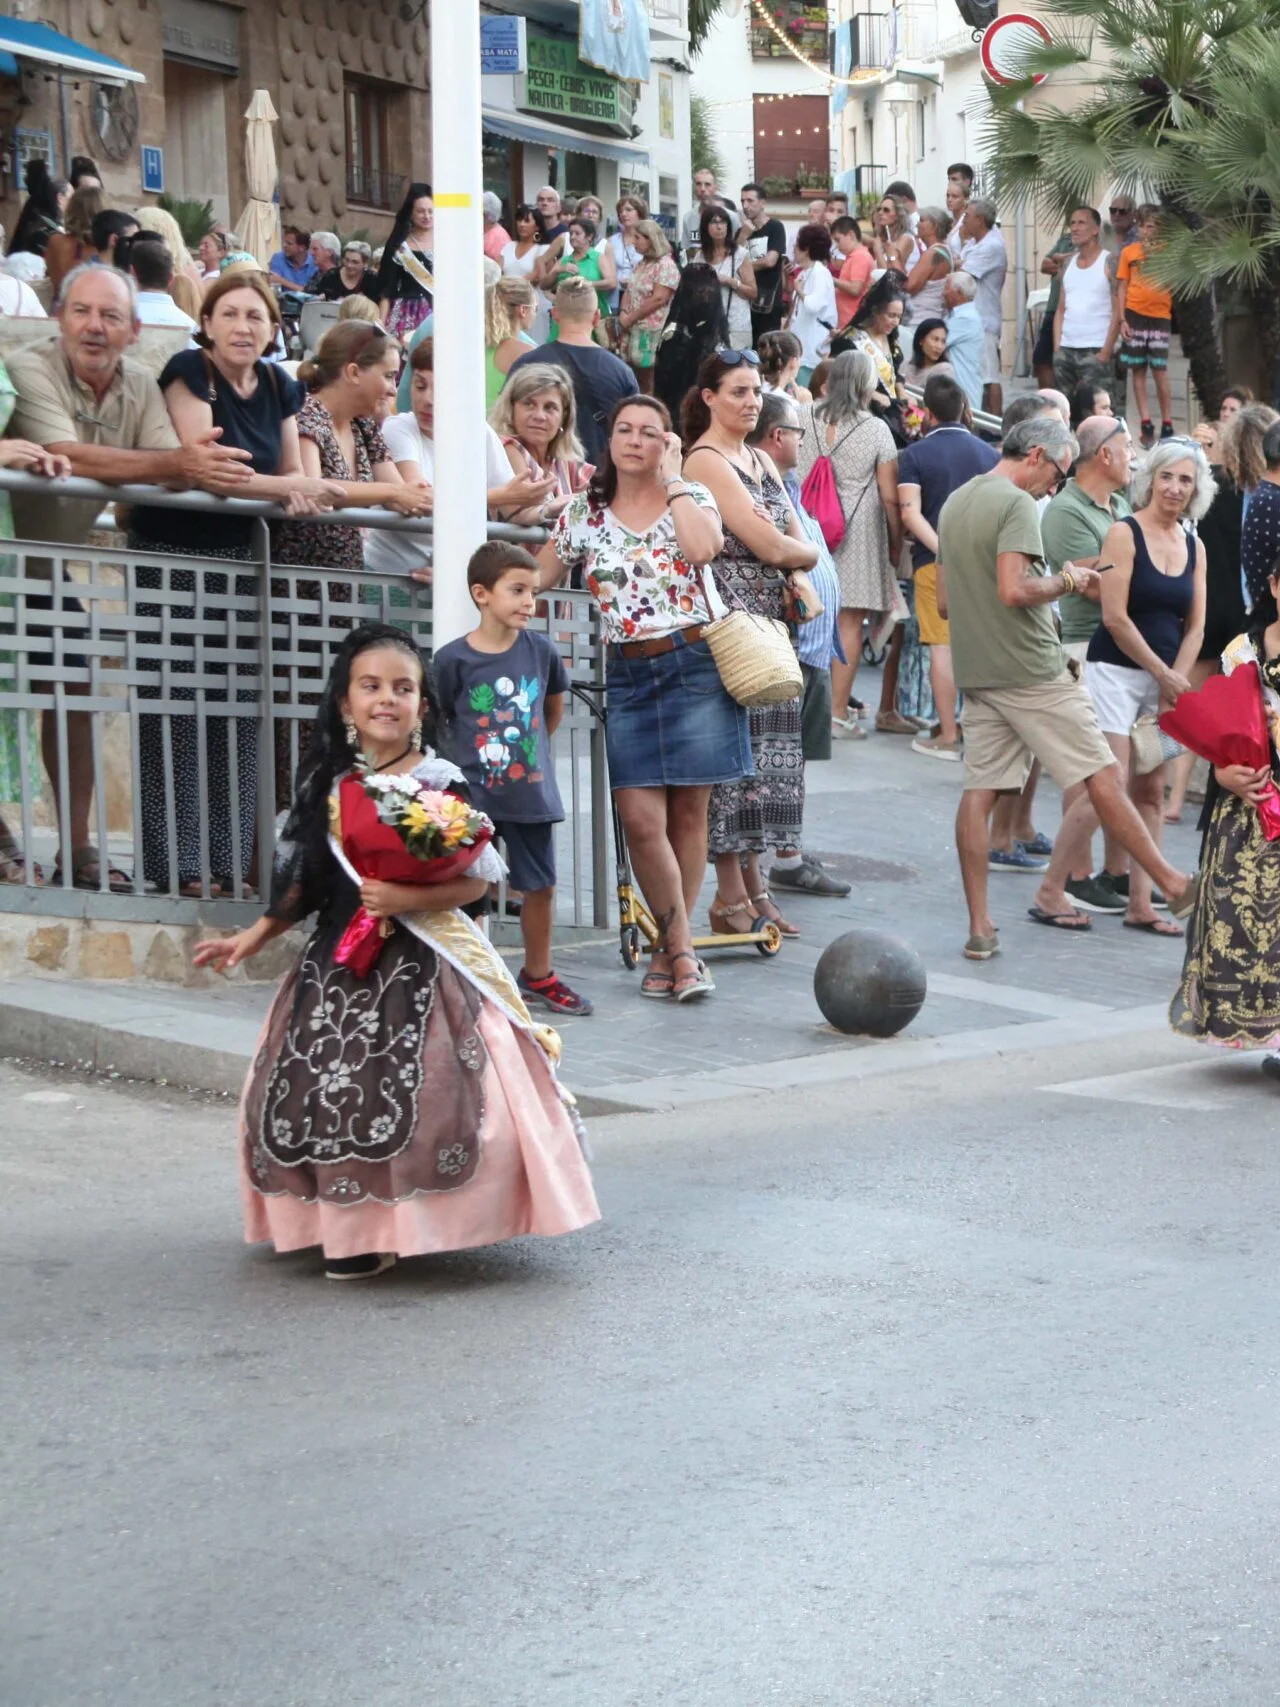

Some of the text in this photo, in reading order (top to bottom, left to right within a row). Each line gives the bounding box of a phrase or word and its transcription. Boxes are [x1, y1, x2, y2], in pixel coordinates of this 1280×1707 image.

[497, 48, 518, 56] MATA
[528, 69, 615, 99] PESCA CEBOS VIVOS
[528, 89, 564, 111] NAUTICA
[148, 151, 158, 175] H
